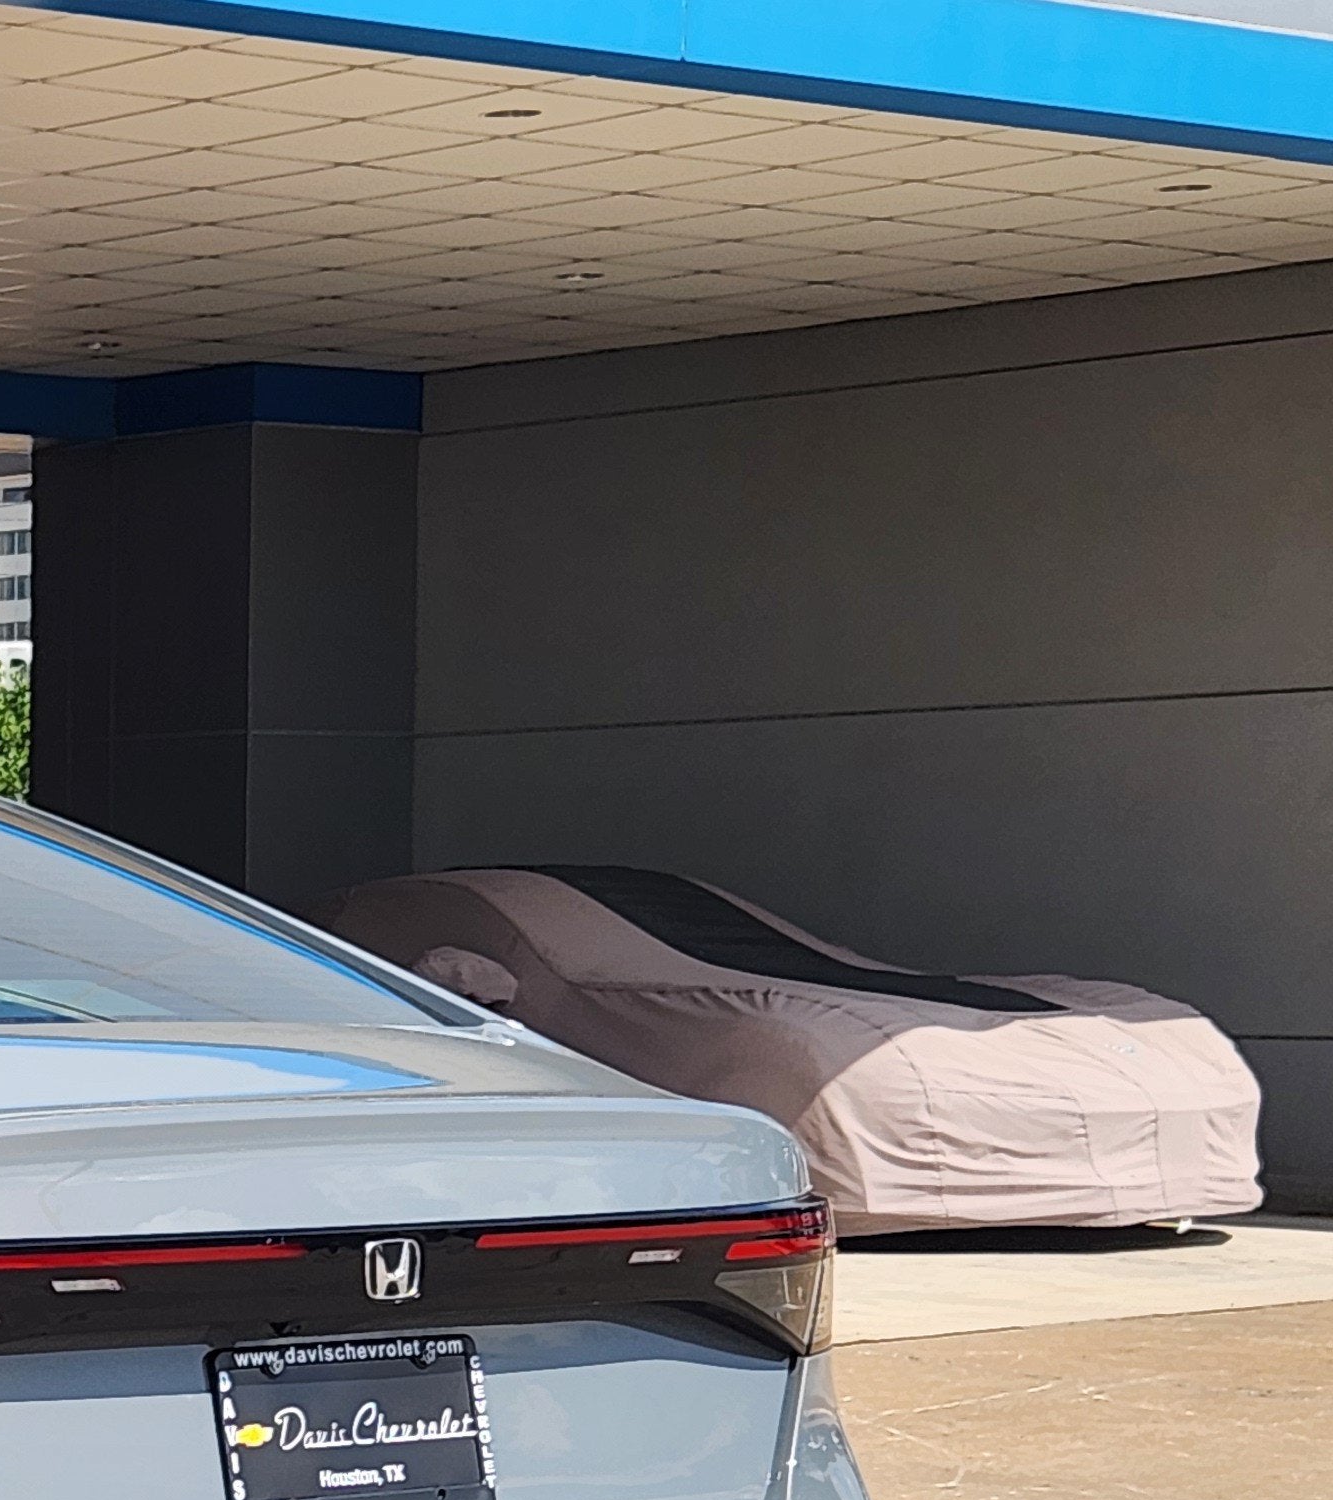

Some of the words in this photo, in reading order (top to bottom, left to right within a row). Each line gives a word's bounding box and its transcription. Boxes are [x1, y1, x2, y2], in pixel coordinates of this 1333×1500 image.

[234, 1339, 463, 1367] wwwdavischevroletcom
[219, 1371, 246, 1500] DAVIS
[274, 1406, 353, 1450] Davis
[352, 1402, 477, 1445] Chevrolet
[470, 1355, 496, 1489] CHEVROLET
[319, 1468, 383, 1487] Houston,
[383, 1464, 406, 1482] TX
